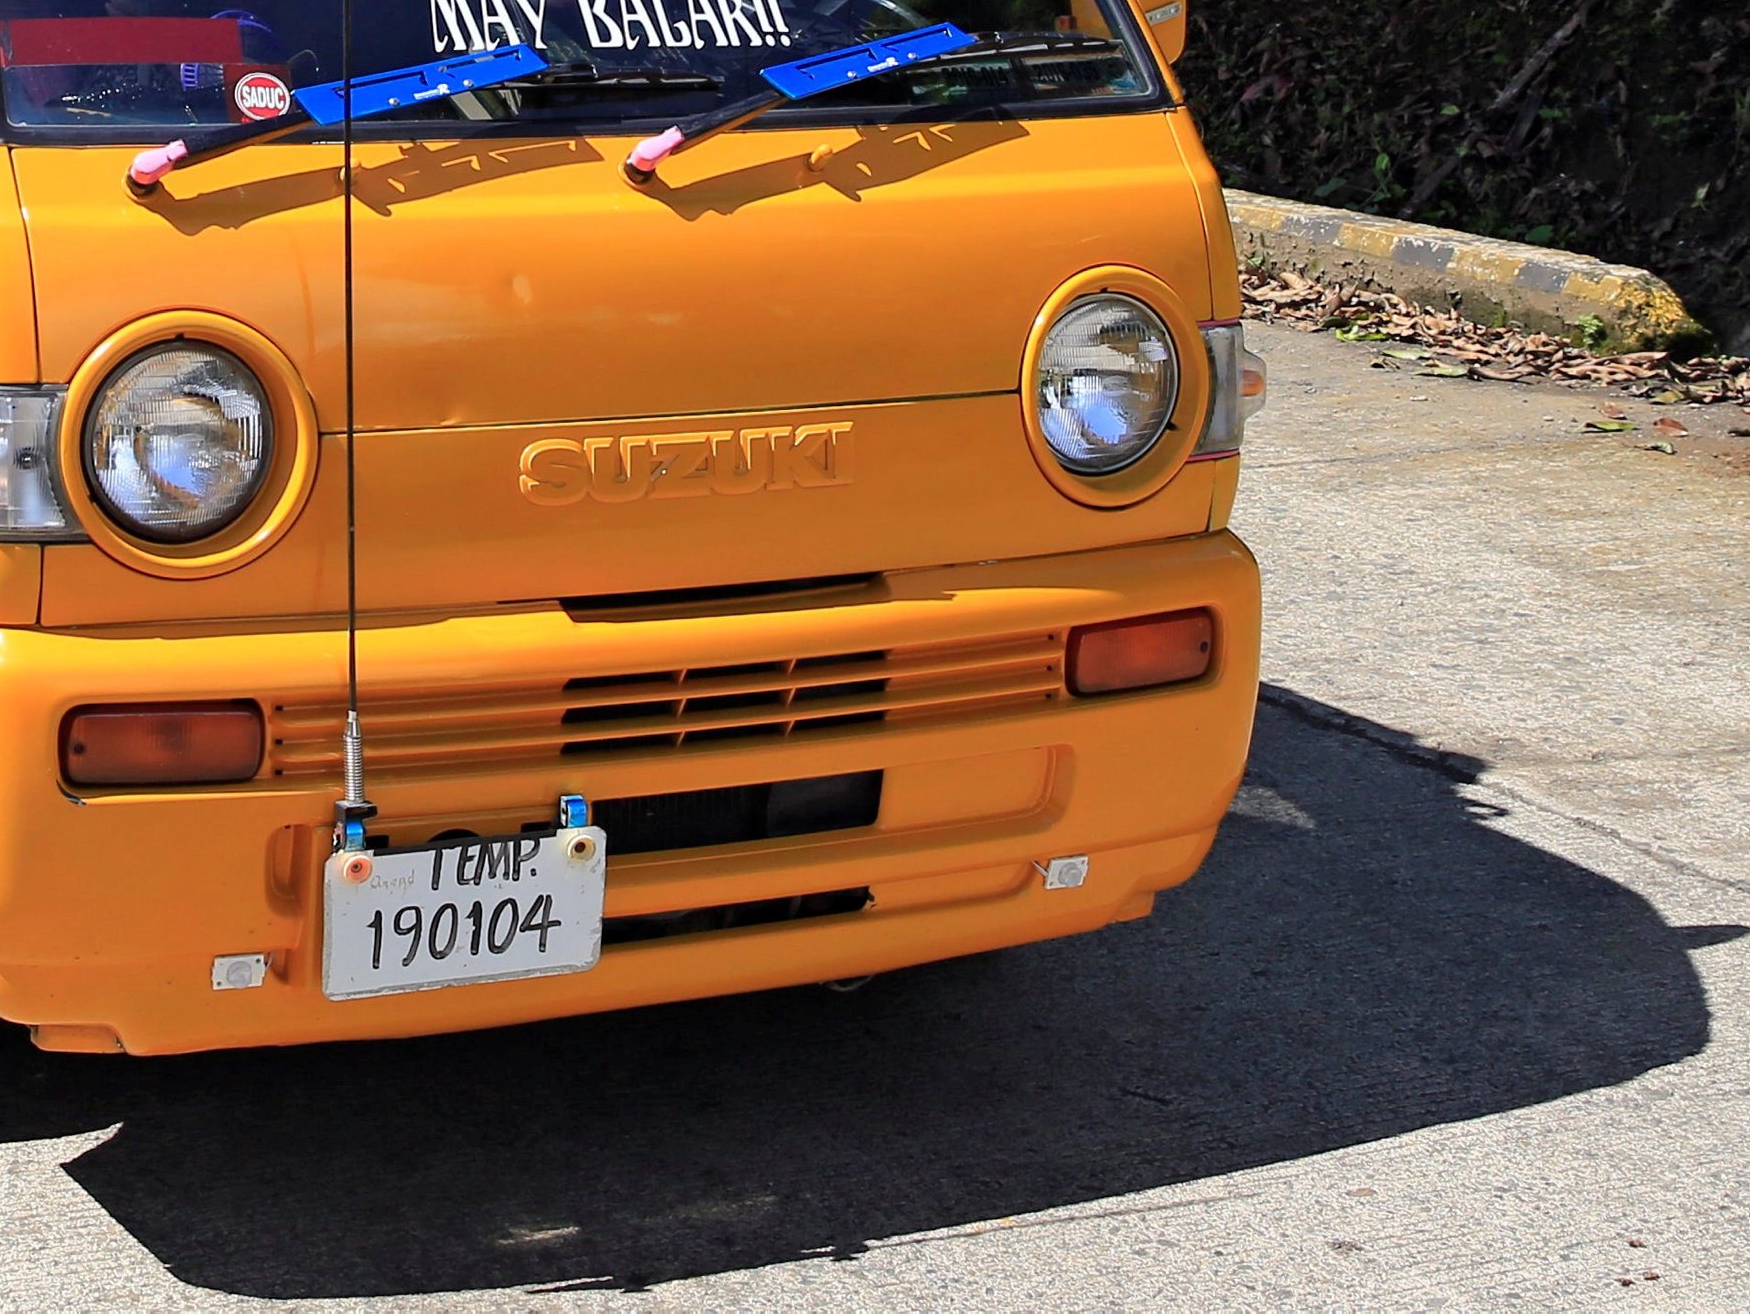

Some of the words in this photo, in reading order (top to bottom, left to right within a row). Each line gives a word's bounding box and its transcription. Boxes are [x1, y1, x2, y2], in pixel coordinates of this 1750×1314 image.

[242, 85, 285, 110] SADUC
[518, 420, 855, 508] SUZUKI
[430, 838, 542, 891] TEMP.
[366, 893, 562, 970] 190104
